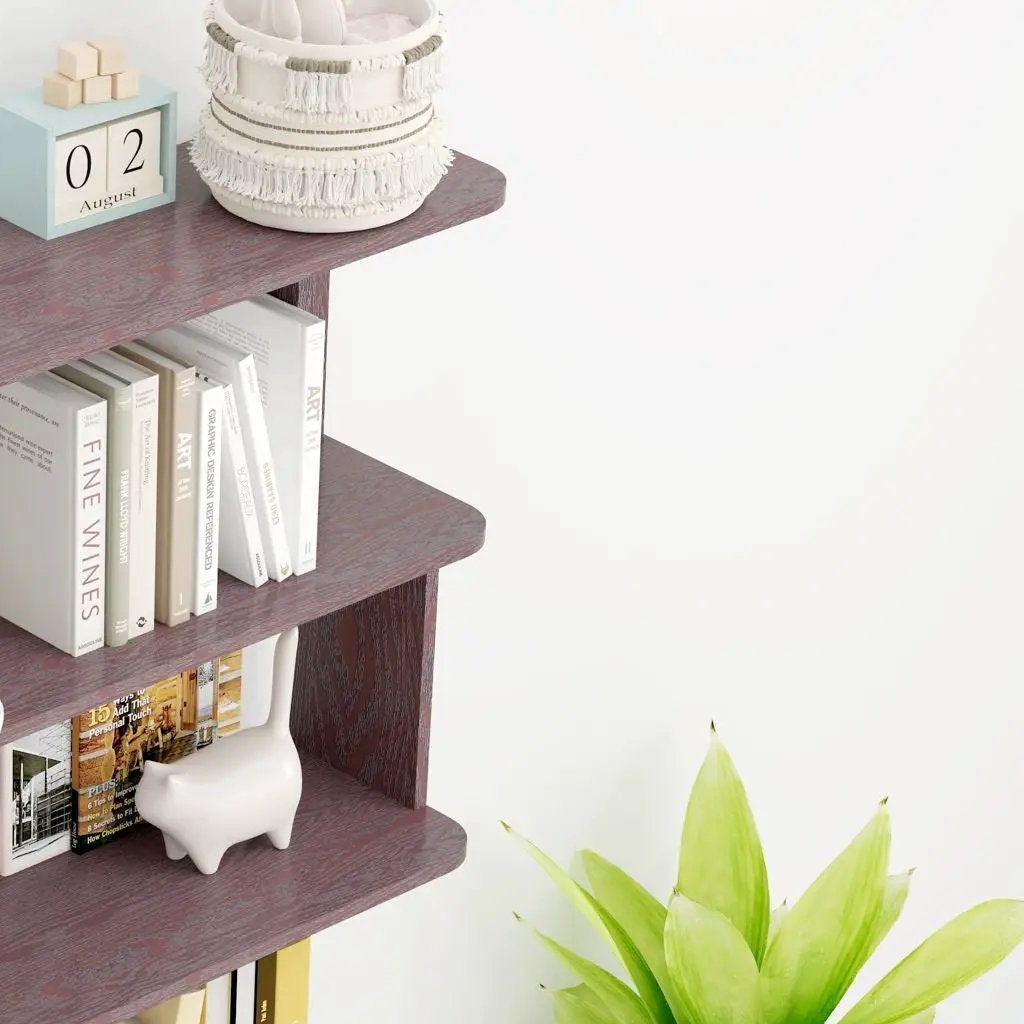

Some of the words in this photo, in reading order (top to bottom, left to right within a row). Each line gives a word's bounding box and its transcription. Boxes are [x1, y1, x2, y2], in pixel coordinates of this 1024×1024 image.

[65, 144, 92, 189] 0
[122, 128, 145, 175] 2
[79, 187, 137, 213] August
[305, 386, 321, 421] ART
[207, 408, 217, 456] GRAPHIC
[176, 432, 193, 470] ART
[82, 439, 102, 510] FINE
[206, 459, 216, 498] DESIGN
[204, 501, 215, 570] REFERENCED
[81, 519, 101, 621] WINES
[88, 704, 111, 727] 15
[89, 716, 125, 739] Personal
[128, 706, 152, 723] Touch
[114, 703, 129, 717] Add
[132, 696, 150, 709] That
[88, 778, 118, 798] PLUS:
[87, 835, 100, 844] How
